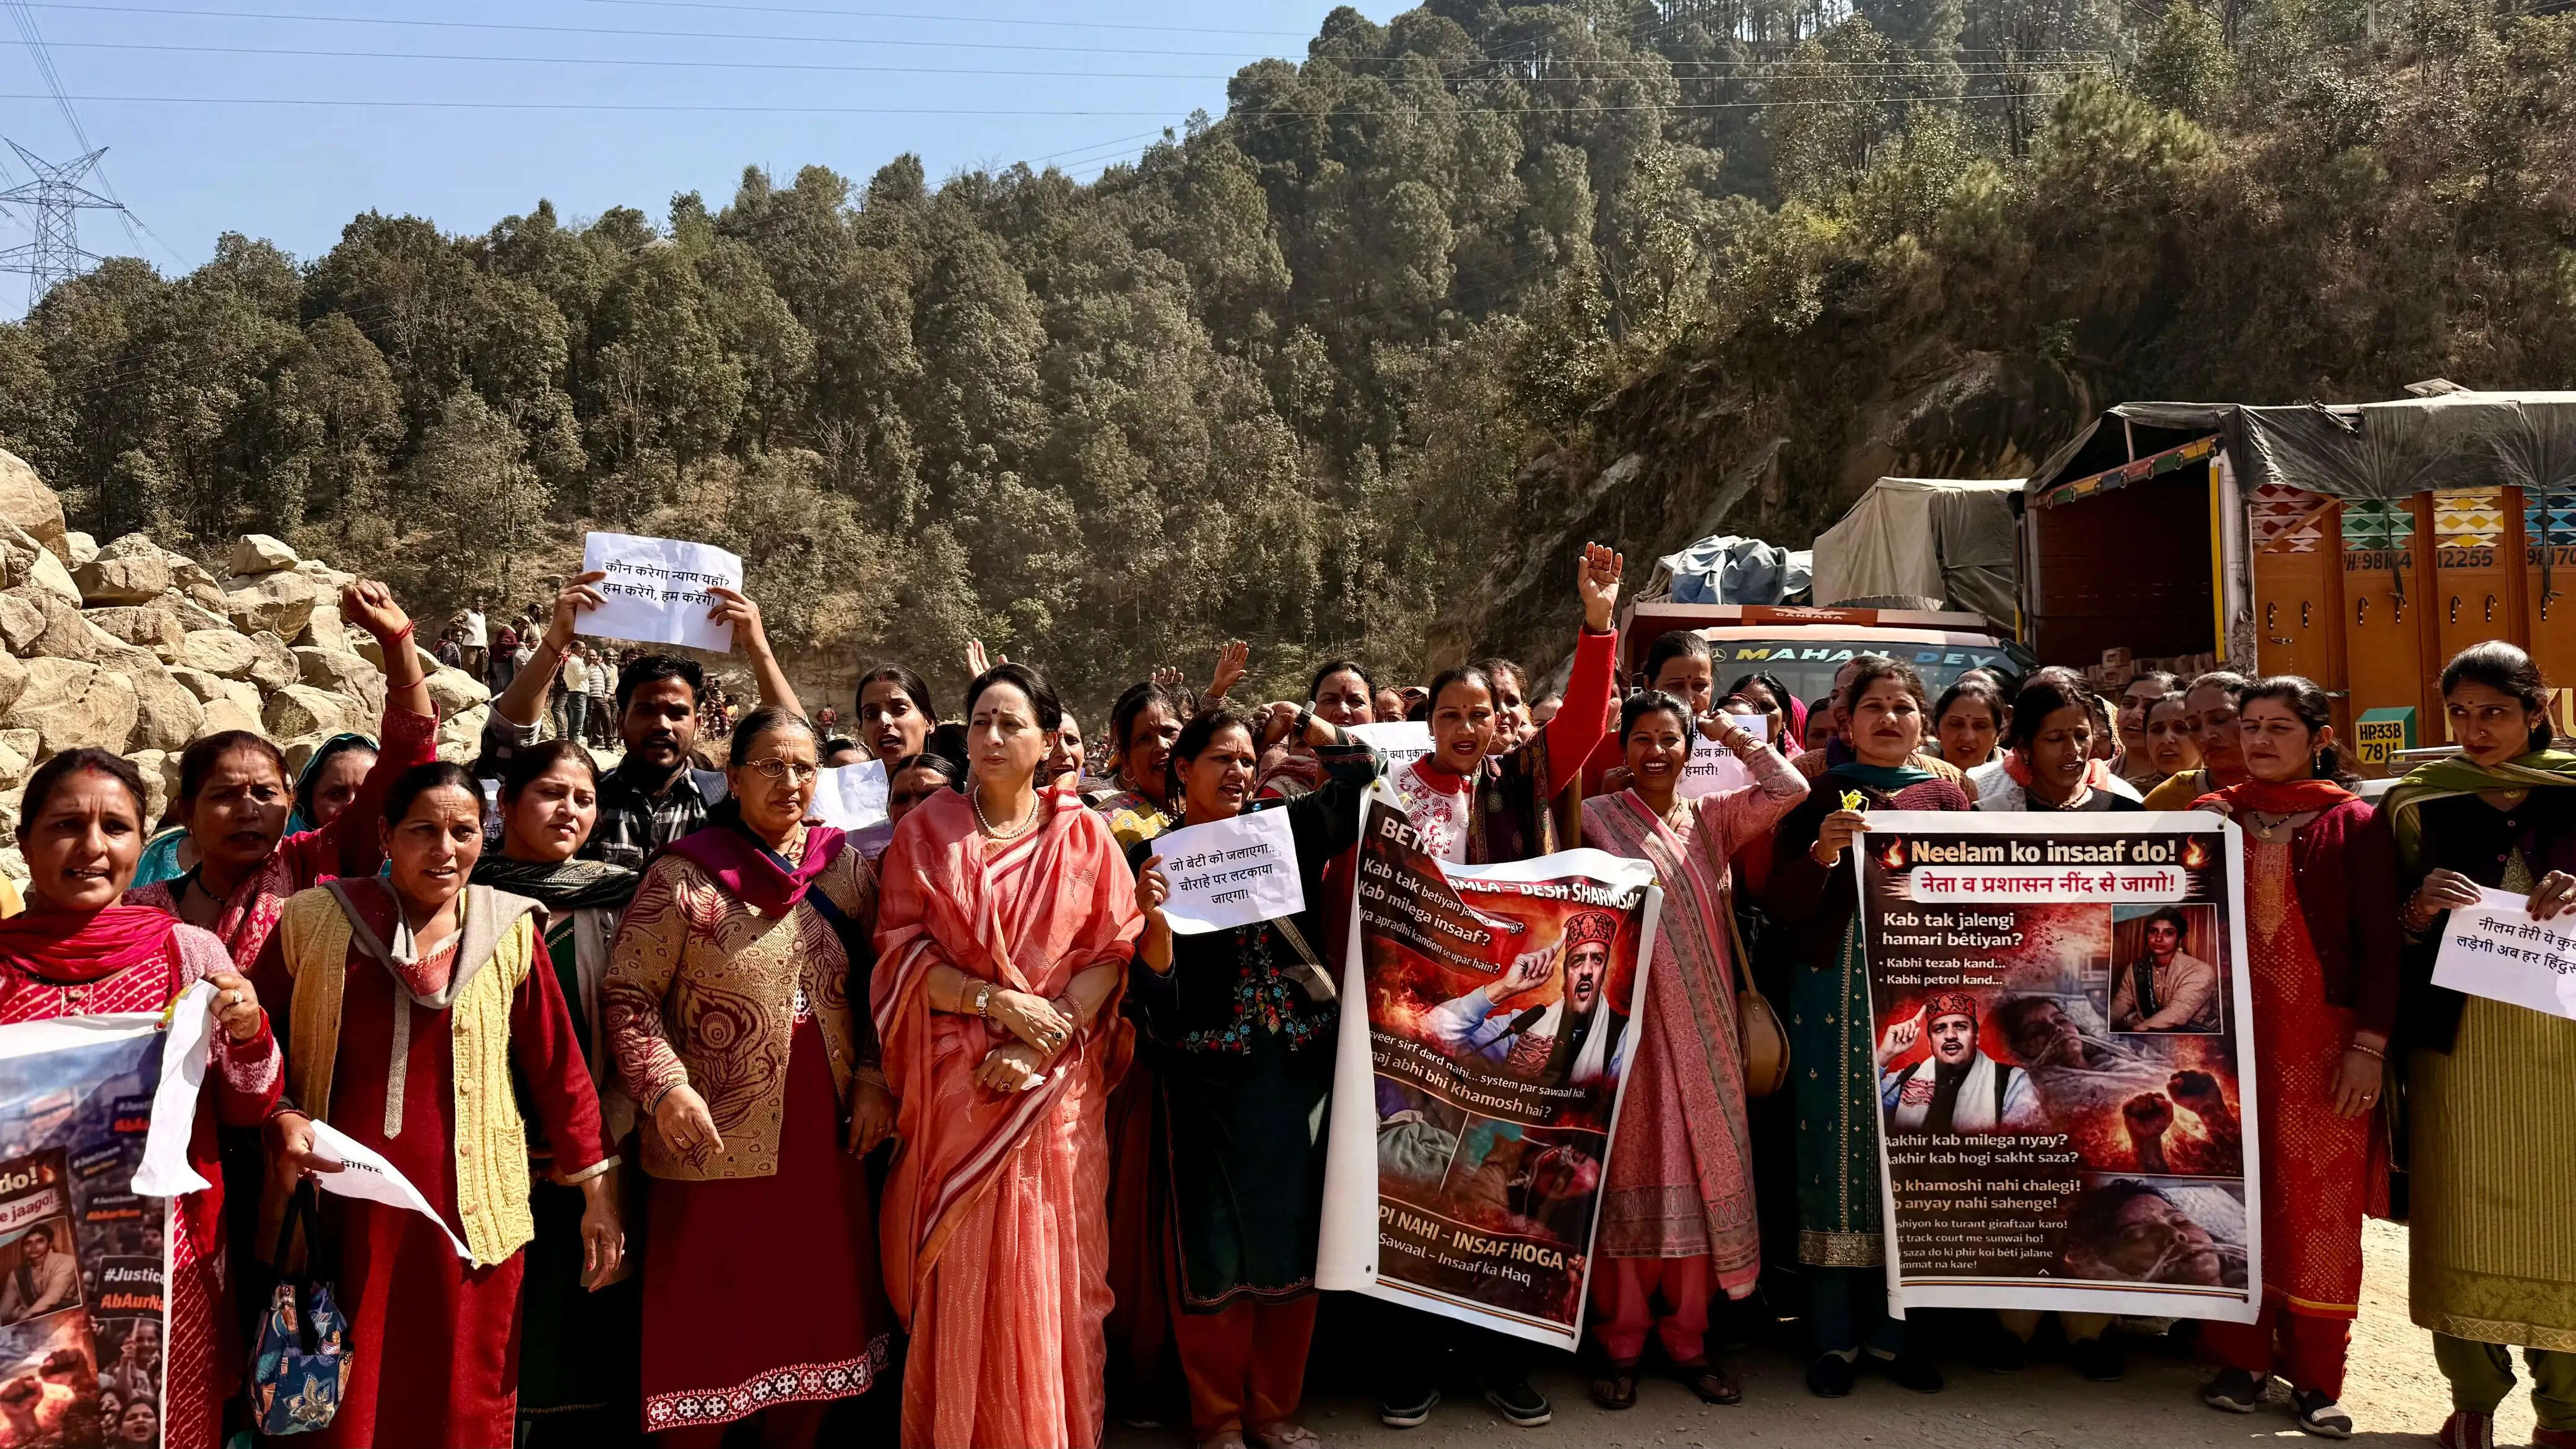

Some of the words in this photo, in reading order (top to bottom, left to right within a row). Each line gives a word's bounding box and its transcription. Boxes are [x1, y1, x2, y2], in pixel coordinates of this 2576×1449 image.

[2437, 549, 2493, 568] 12255
[605, 559, 630, 575] कौन
[635, 564, 669, 580] करेगा
[672, 570, 699, 582] न्याय
[701, 573, 729, 587] यहाँ?
[602, 582, 620, 594] हम
[625, 583, 657, 601] करेंगे,
[662, 590, 678, 603] हम
[682, 591, 715, 607] करेंगे!
[1913, 652, 1996, 668] DEV
[1389, 747, 1404, 759] क्या
[1380, 816, 1429, 855] BET
[1169, 858, 1183, 872] जो
[1186, 854, 1206, 868] बेटी
[1208, 850, 1224, 864] को
[1912, 841, 2004, 863] Neelam
[2011, 841, 2040, 863] ko
[2047, 840, 2126, 862] insaaf
[2132, 840, 2175, 862] do!
[1179, 874, 1210, 892] चौराहे
[1212, 873, 1227, 885] पर
[1230, 864, 1273, 882] लटकाया
[1364, 858, 1392, 879] Kab
[1396, 871, 1420, 894] tak
[1422, 886, 1460, 912] betiyan
[1920, 871, 1957, 892] नेता
[1962, 877, 1977, 892] व
[1981, 877, 2054, 892] प्रशासन
[2058, 871, 2094, 893] नींद
[2098, 871, 2116, 892] से
[2120, 871, 2175, 892] जागो!
[1211, 889, 1249, 904] जाएगा!
[1520, 884, 1568, 900] DESH
[1359, 881, 1385, 900] Kab
[1388, 894, 1431, 923] milega
[1434, 914, 1491, 946] insaaf?
[1884, 912, 1919, 926] Kab
[1924, 913, 1954, 927] tak
[1957, 913, 2014, 930] jalengi
[1882, 932, 1942, 946] hamari
[2479, 916, 2517, 936] नीलम
[2519, 924, 2541, 941] तेरी
[2544, 929, 2556, 944] ये
[1375, 915, 1412, 937] apradhi
[1443, 949, 1450, 959] se
[1451, 954, 1472, 966] upar
[1473, 959, 1500, 975] hain?
[2457, 935, 2494, 952] लड़ेगी
[2497, 945, 2520, 959] अब
[2522, 950, 2541, 964] हर
[1887, 958, 1921, 968] Kabhi
[1925, 958, 1960, 968] tezab
[1964, 958, 2006, 968] kand...
[1887, 975, 1921, 985] Kabhi
[1924, 975, 1959, 986] petrol
[1963, 975, 2003, 985] kand...
[1398, 1040, 1420, 1053] sirf
[1419, 1048, 1445, 1066] dard
[1480, 1074, 1518, 1089] system
[1520, 1083, 1538, 1094] par
[1538, 1086, 1573, 1098] sawaal
[1392, 1058, 1424, 1077] abhi
[1425, 1069, 1449, 1089] bhi
[1450, 1081, 1523, 1113] khamosh
[1933, 1134, 1960, 1146] kab
[1965, 1134, 2015, 1148] milega
[2020, 1134, 2068, 1148] nyay?
[1930, 1152, 1956, 1164] kab
[1959, 1152, 1990, 1166] hogi
[1995, 1152, 2034, 1163] sakht
[2039, 1152, 2079, 1163] saza?
[1905, 1179, 1982, 1191] khamoshi
[1986, 1179, 2019, 1191] nahi
[2022, 1179, 2081, 1194] chalegi!
[12, 1191, 54, 1222] jaago!
[1905, 1199, 1951, 1211] anyay
[1956, 1197, 1986, 1208] nahi
[1991, 1197, 2057, 1212] sahenge!
[1896, 1219, 1931, 1229] shiyon
[1934, 1219, 1948, 1227] ko
[1952, 1220, 1986, 1228] turant
[1989, 1219, 2035, 1230] giraftaar
[2039, 1219, 2068, 1229] karo!
[1397, 1212, 1440, 1241] NAHI
[1452, 1231, 1510, 1257] INSAF
[1510, 1243, 1564, 1270] HOGA
[1907, 1234, 1933, 1242] track
[1985, 1234, 2022, 1242] sunwai
[2026, 1234, 2043, 1243] ho!
[1378, 1232, 1426, 1259] Sawaal
[1438, 1252, 1482, 1273] Insaaf
[1482, 1261, 1497, 1276] ka
[1501, 1266, 1531, 1287] Haq
[1928, 1248, 1942, 1256] do
[1944, 1248, 1953, 1256] ki
[1956, 1248, 1977, 1258] phir
[1978, 1248, 1995, 1256] koi
[2019, 1248, 2053, 1258] jalane
